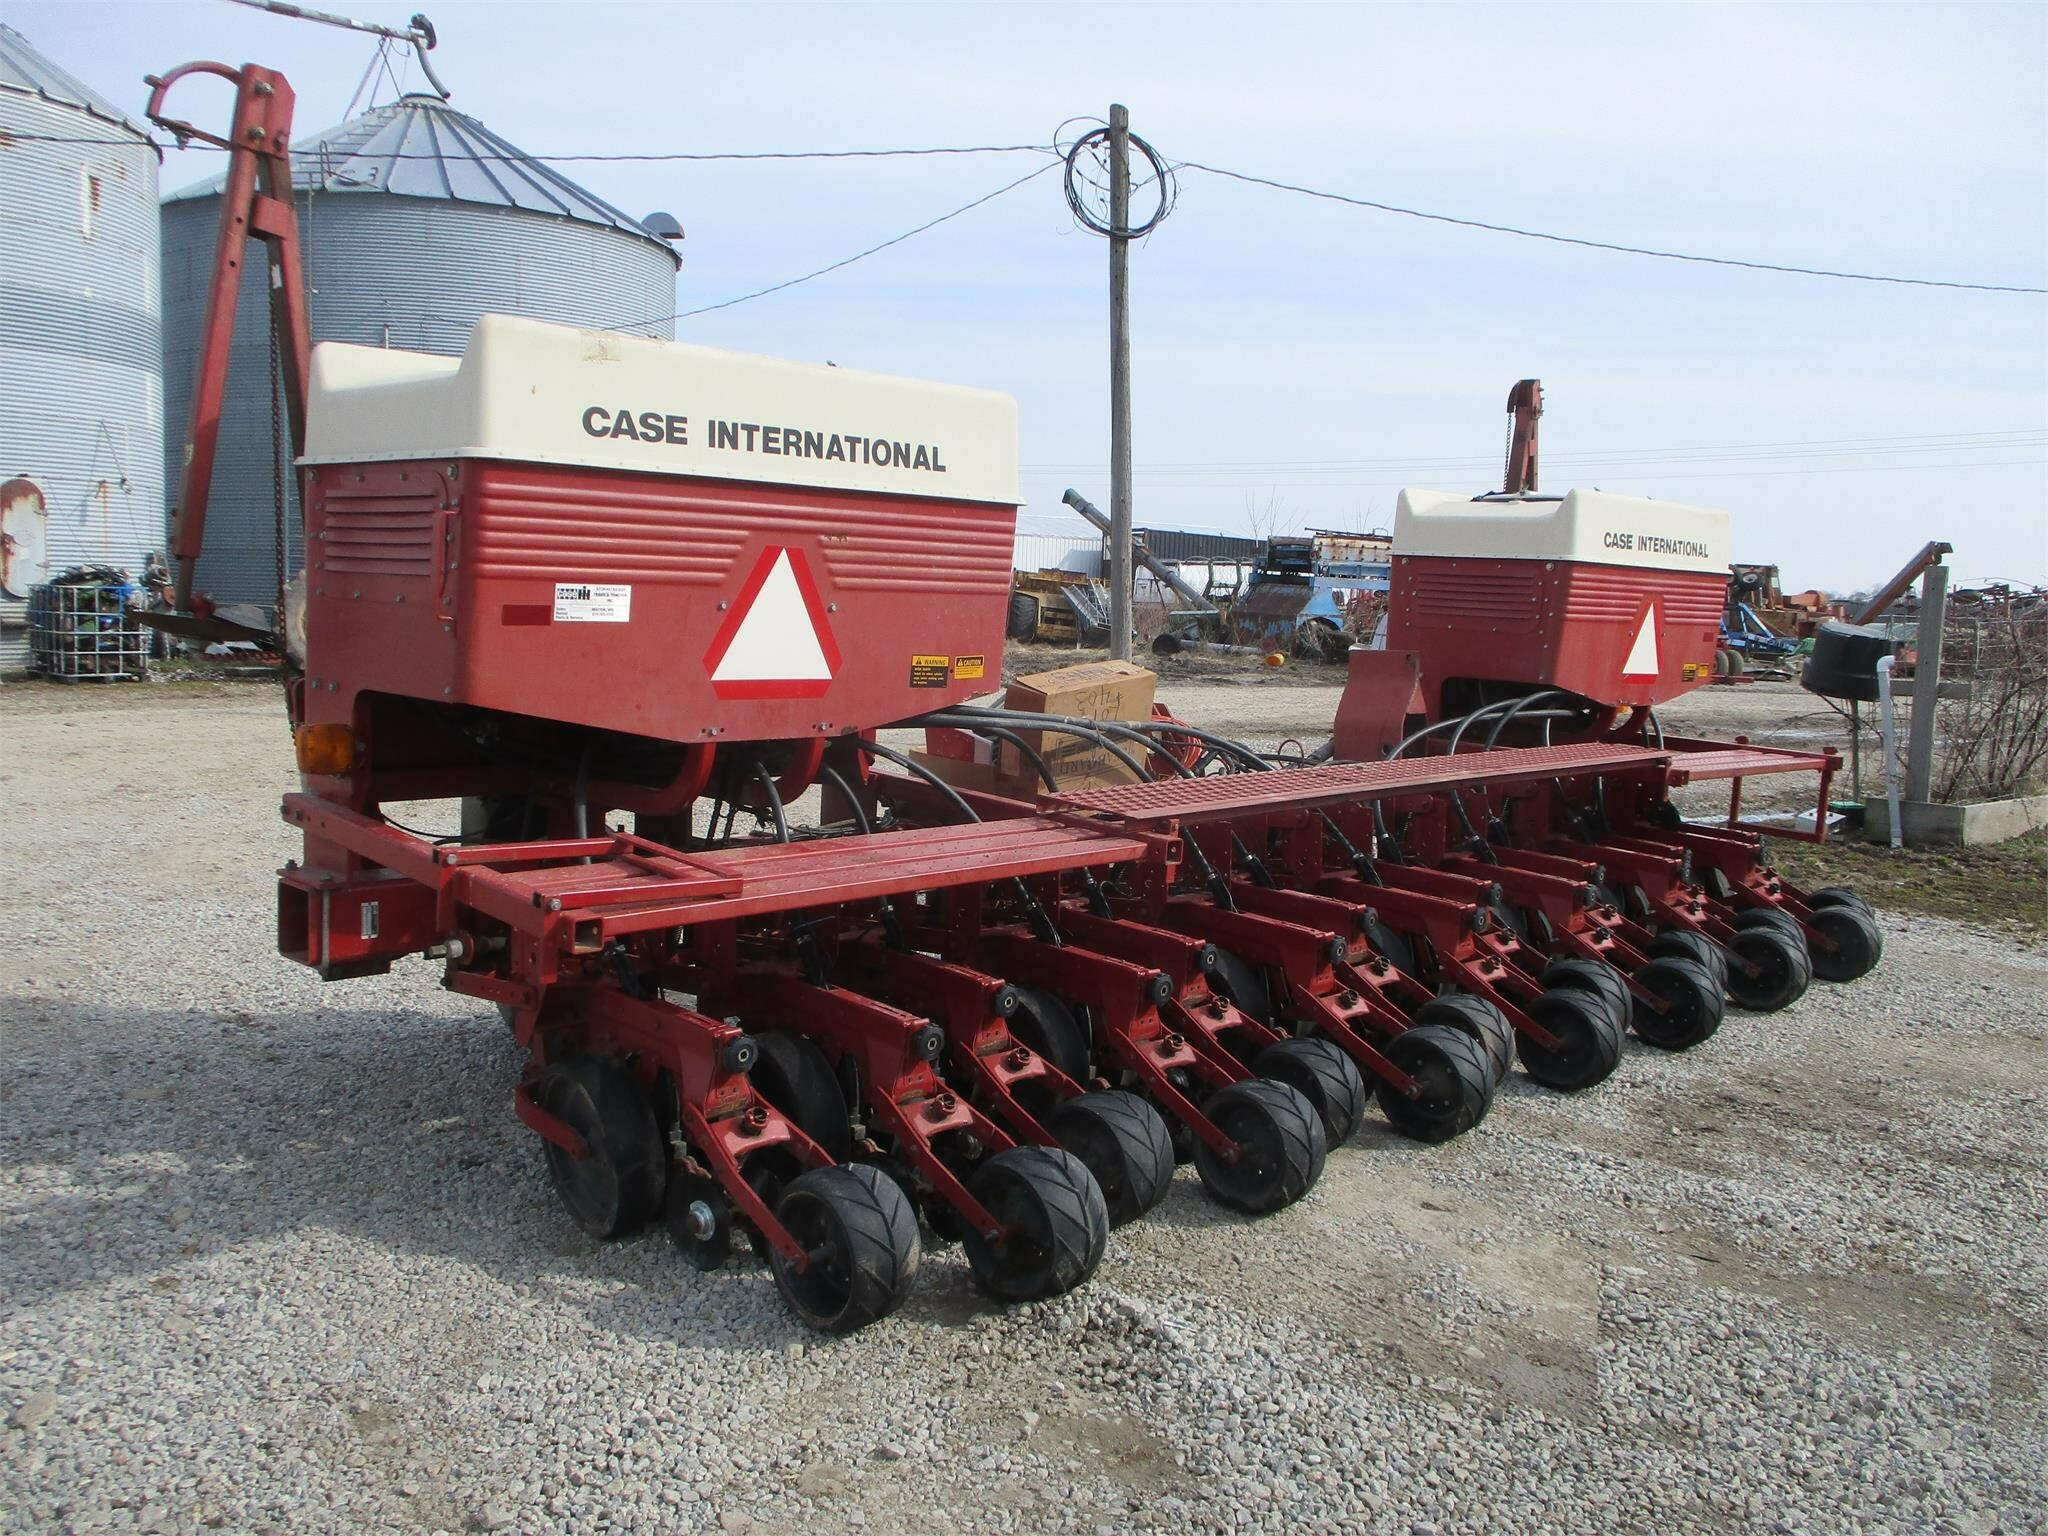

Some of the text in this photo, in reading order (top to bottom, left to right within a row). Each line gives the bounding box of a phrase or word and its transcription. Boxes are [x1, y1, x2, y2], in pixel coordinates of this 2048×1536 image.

[582, 406, 946, 472] CASE INTERNATIONAL
[1604, 532, 1709, 558] CASE INTERNATIONAL
